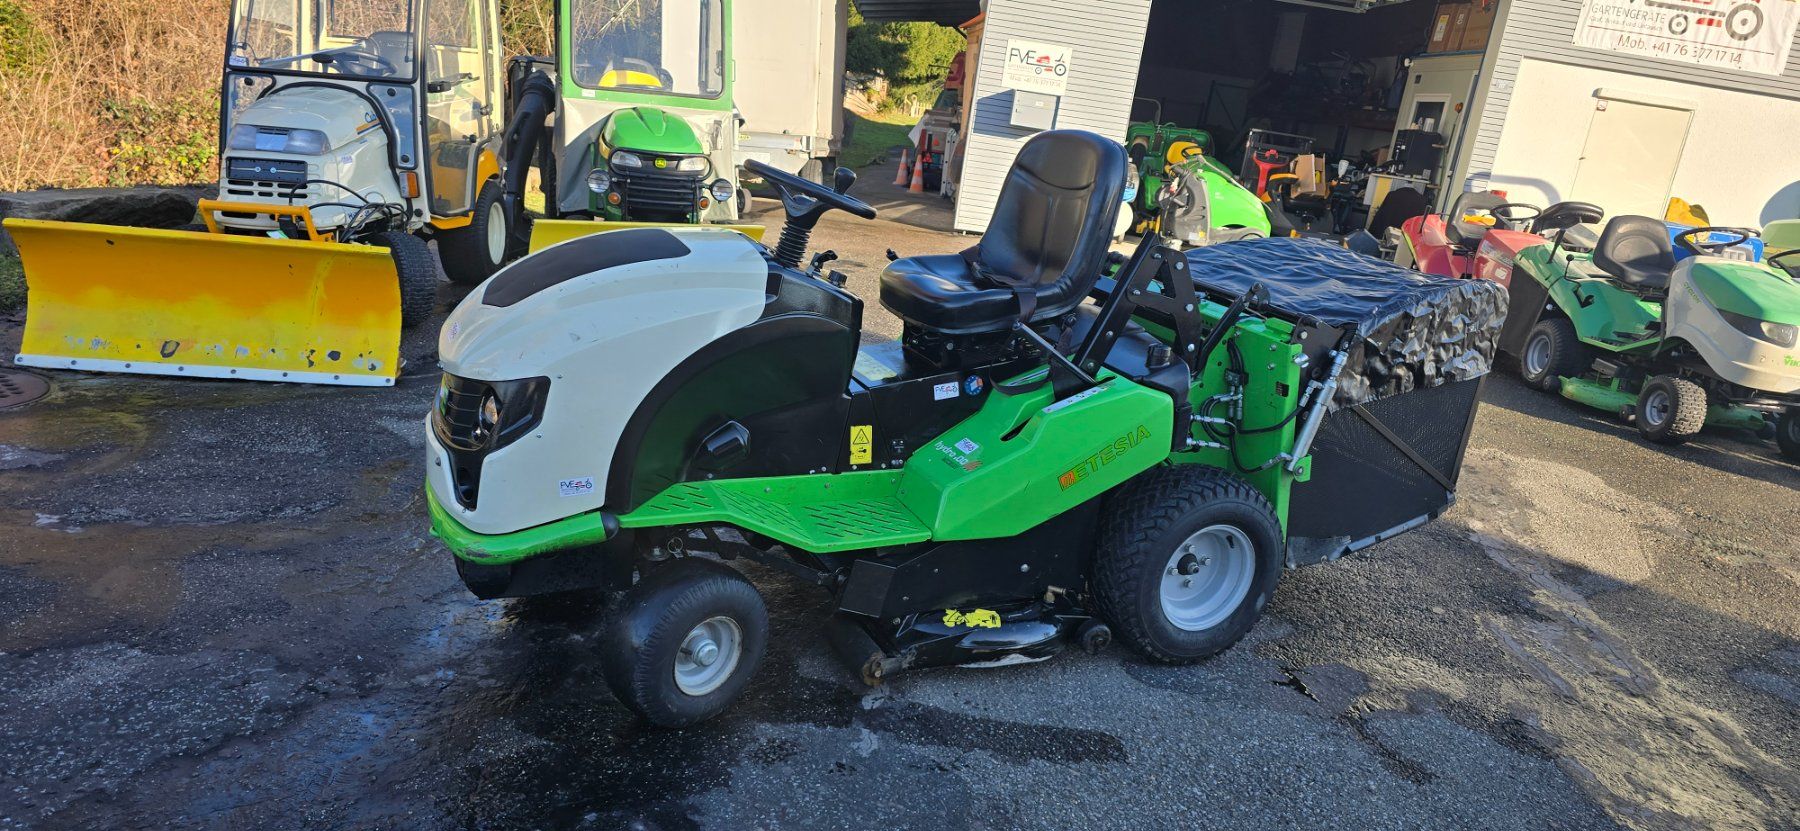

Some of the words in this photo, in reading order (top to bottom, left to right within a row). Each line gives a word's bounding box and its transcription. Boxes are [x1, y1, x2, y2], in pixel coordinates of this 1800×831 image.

[1009, 47, 1037, 65] FVE
[1617, 34, 1648, 51] Mob.
[1652, 41, 1671, 54] +41
[1673, 43, 1689, 56] 76
[1692, 46, 1713, 60] 377
[1715, 49, 1727, 61] 17
[1730, 52, 1742, 64] 14
